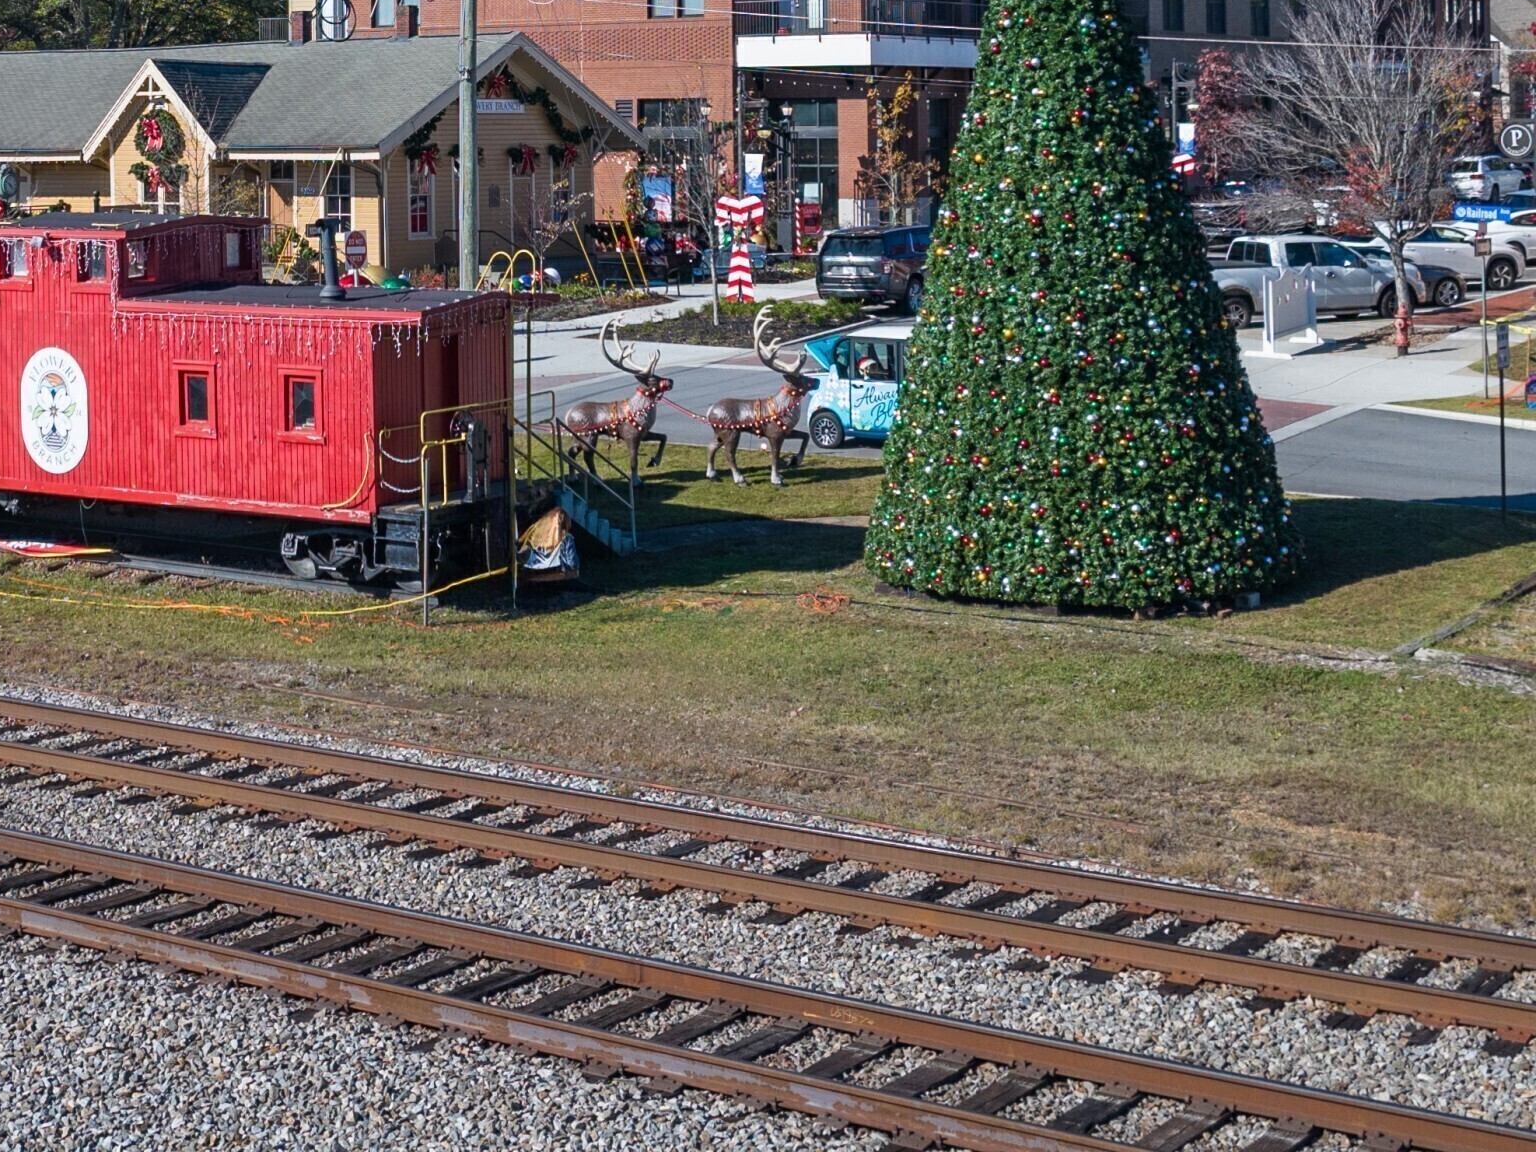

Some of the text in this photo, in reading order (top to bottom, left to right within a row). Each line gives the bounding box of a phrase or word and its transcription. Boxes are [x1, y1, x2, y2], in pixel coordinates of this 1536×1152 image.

[495, 101, 521, 111] BRANCH
[1510, 129, 1523, 147] P
[1466, 207, 1498, 219] Railroad
[29, 355, 77, 384] FLOWERY
[32, 440, 77, 466] BRANCH
